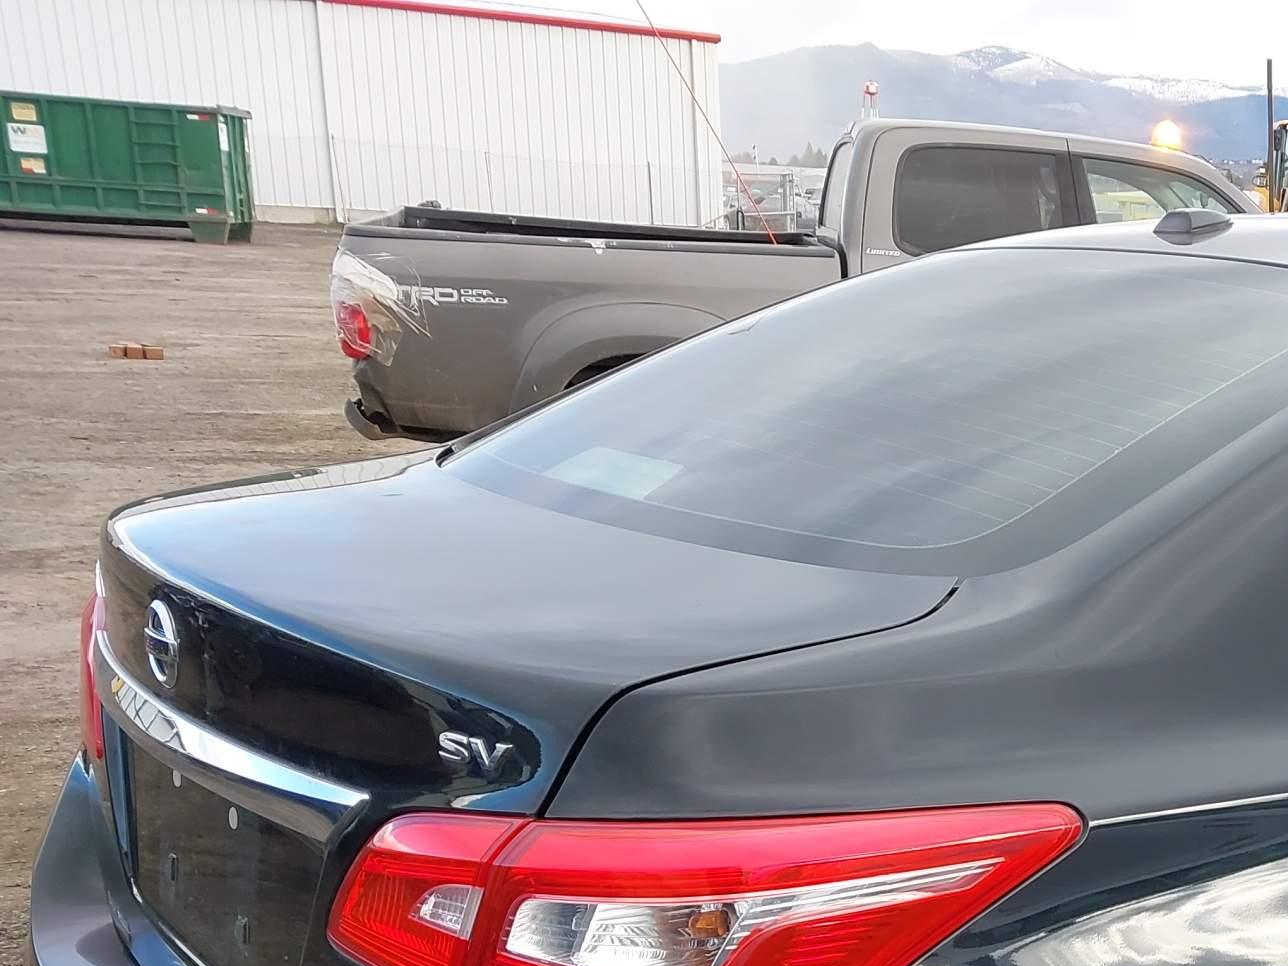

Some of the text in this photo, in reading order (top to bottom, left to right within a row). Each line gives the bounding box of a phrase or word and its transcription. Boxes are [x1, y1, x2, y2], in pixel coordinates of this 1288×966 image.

[398, 285, 459, 305] TRD
[460, 296, 509, 304] ROAD
[439, 731, 514, 770] SV
